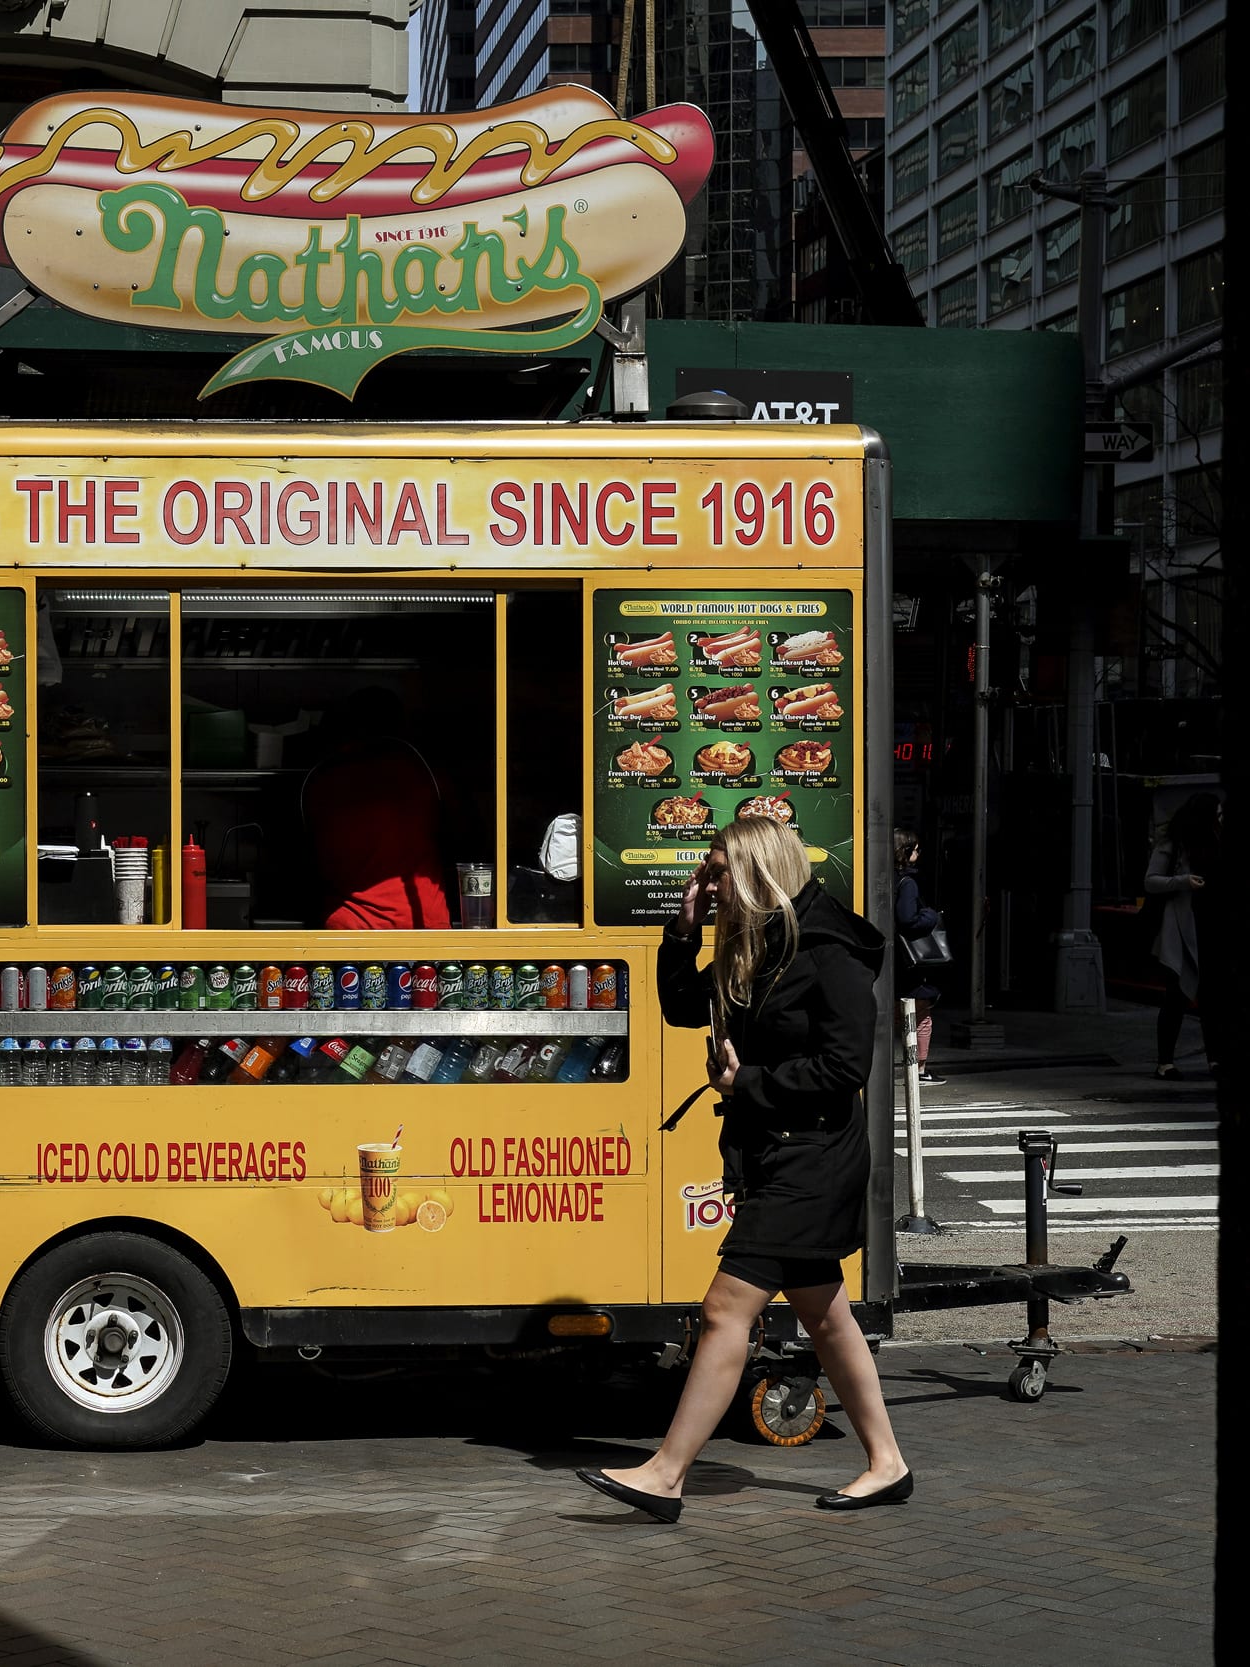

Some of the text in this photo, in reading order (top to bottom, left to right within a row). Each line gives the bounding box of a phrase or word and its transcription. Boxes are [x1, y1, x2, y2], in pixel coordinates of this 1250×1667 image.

[374, 225, 449, 243] SINCE 1916
[98, 181, 591, 328] Nathan's
[272, 329, 383, 364] FAMOUS
[751, 401, 840, 425] AT&T
[1102, 434, 1139, 451] WAY
[16, 479, 141, 544] THE
[162, 479, 470, 546] ORIGINAL
[489, 481, 679, 546] SINCE
[701, 481, 836, 546] 1916
[660, 604, 693, 613] WORLD
[696, 604, 735, 613] FAMOUS
[737, 604, 757, 613] HOT
[760, 604, 783, 613] DOGS
[785, 604, 793, 613] &
[796, 604, 820, 613] FRIES
[676, 851, 696, 861] ICED
[37, 1141, 307, 1184] ICED COLD BEVERAGES
[450, 1136, 632, 1178] OLD FASHIONED
[368, 1177, 390, 1198] 100
[478, 1182, 604, 1223] LEMONADE
